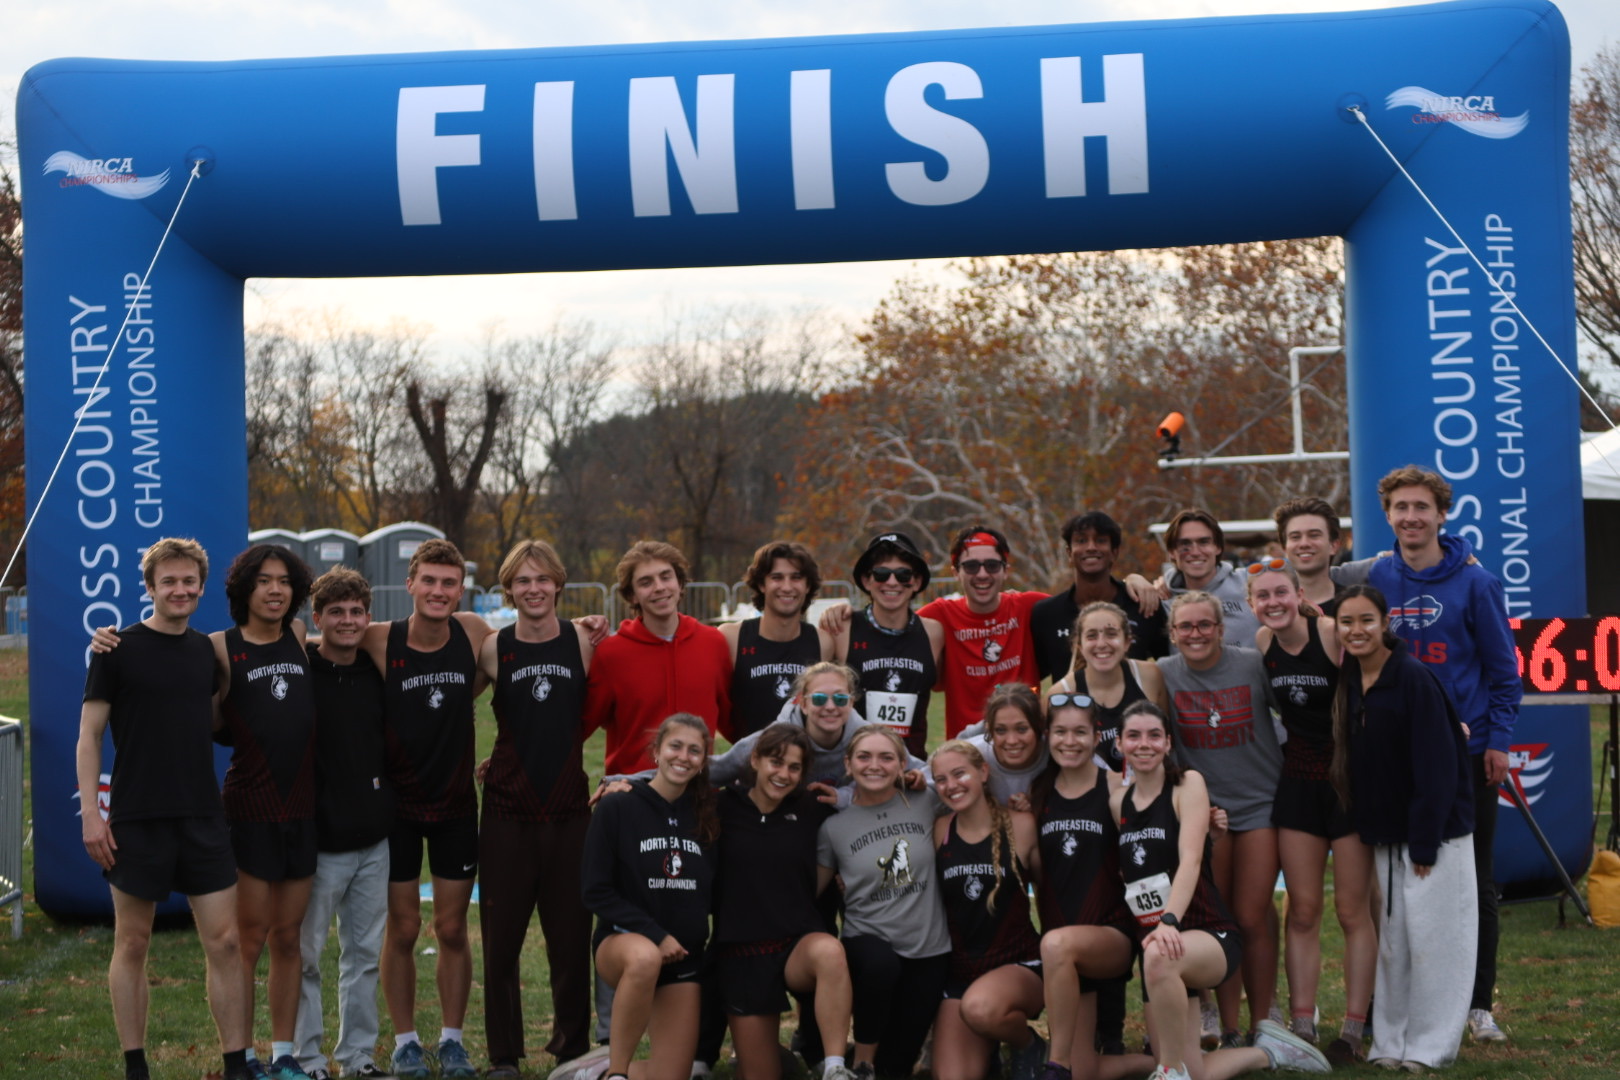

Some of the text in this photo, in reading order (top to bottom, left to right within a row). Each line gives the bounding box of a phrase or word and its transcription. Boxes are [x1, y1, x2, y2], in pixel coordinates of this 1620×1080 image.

[1420, 95, 1496, 112] NIRCA
[1411, 112, 1501, 124] CHAMPIONSHIPS
[396, 53, 1149, 226] FINISH
[66, 157, 134, 177] NIRCA
[59, 173, 138, 189] CHAMPIONSHIPS
[1424, 236, 1480, 480] COUNTRY
[123, 272, 163, 528] CHAMPIONSHIP
[1484, 213, 1532, 619] TIONAL CHAMPIONSHIP
[69, 295, 122, 668] OSS COUNTRY
[246, 663, 304, 682] NORTHEASTERN
[511, 664, 572, 683] NORTHEASTERN
[750, 663, 807, 679] NORTHEASTER
[862, 657, 924, 674] NORTHEASTERN
[966, 666, 987, 677] CLUB
[401, 672, 465, 692] NORTHEASTERN
[1271, 674, 1329, 688] NORTHEASTERN
[877, 704, 906, 722] 425
[1042, 819, 1103, 836] NORTHEASTERN
[640, 836, 702, 856] NORTHEATERN
[849, 822, 926, 855] NORTHEASTERN
[943, 863, 1006, 881] NORTHEASTEN
[648, 878, 697, 890] CLUB RUNNING
[870, 880, 928, 902] CLUB RUNNING
[1135, 890, 1164, 911] 435
